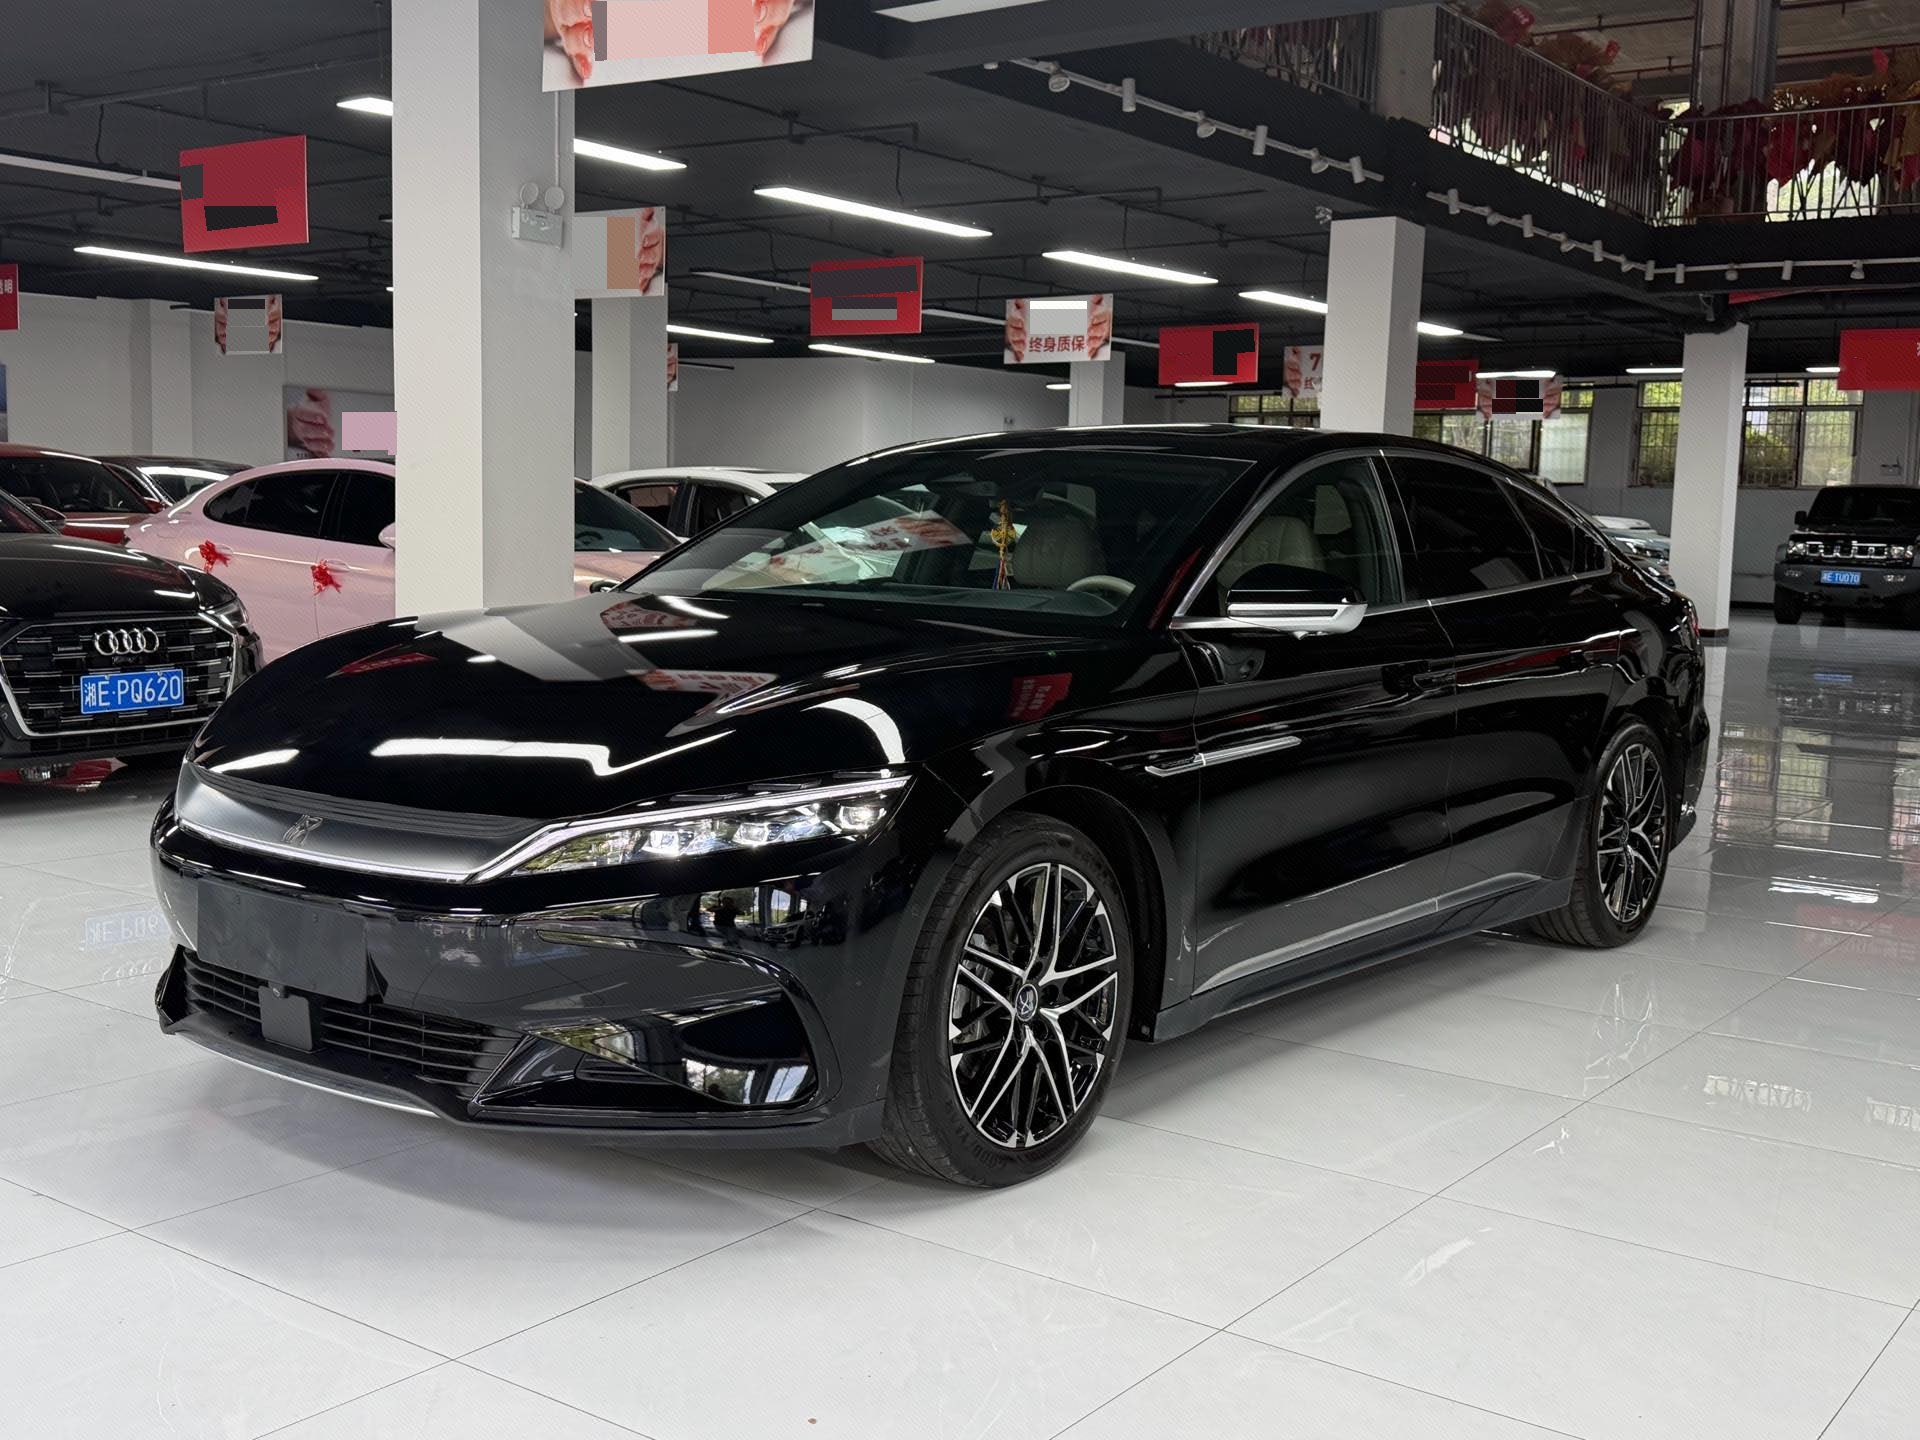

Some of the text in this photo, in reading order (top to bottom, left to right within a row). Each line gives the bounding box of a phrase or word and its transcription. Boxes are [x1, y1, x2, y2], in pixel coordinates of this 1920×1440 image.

[1029, 335, 1085, 352] 终身质保
[84, 675, 181, 707] 湘E·PQ620
